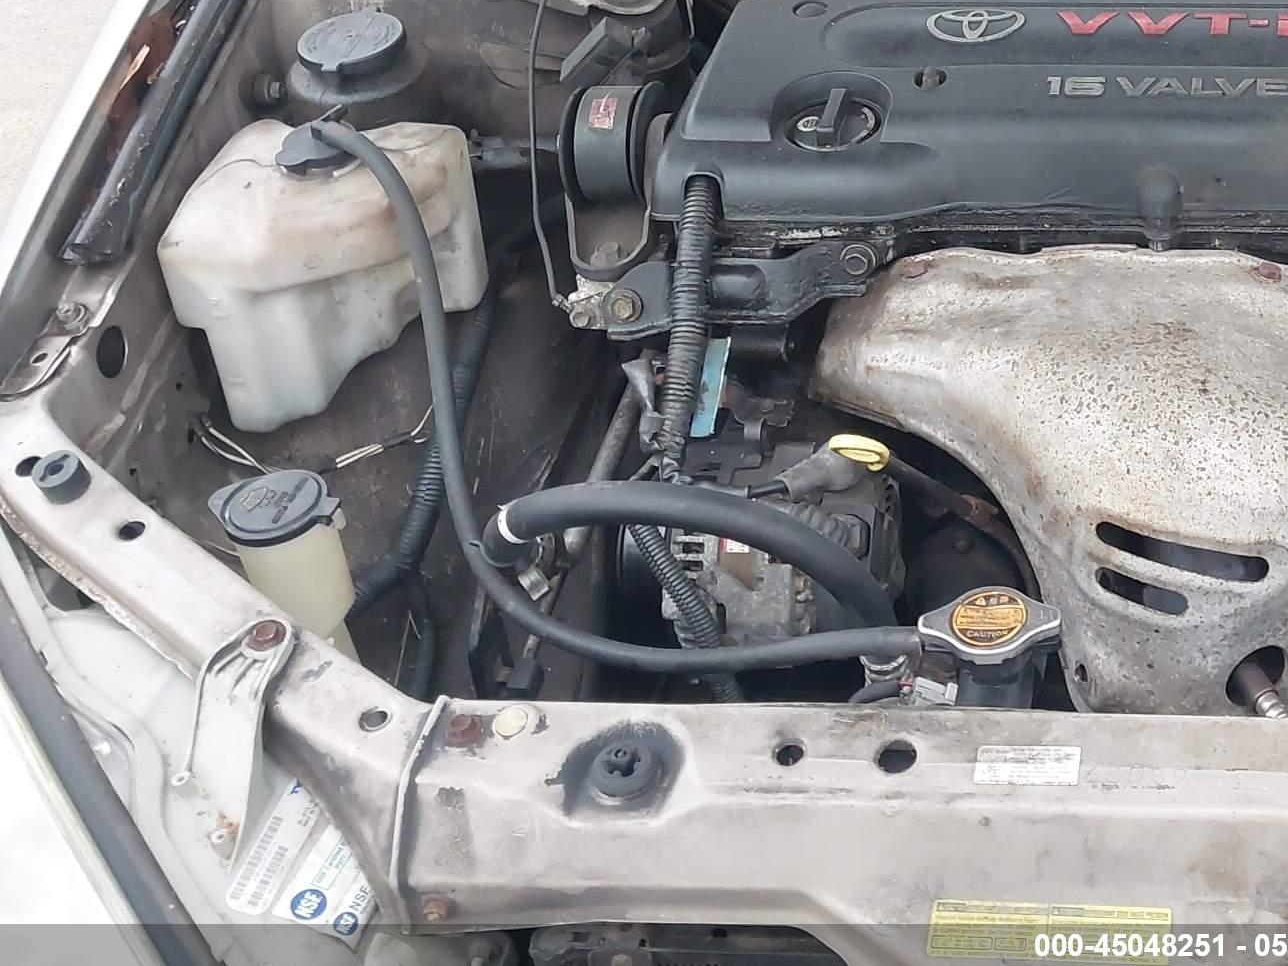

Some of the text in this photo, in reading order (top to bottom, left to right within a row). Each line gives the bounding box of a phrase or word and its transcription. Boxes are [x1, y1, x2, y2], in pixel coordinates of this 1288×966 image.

[1046, 75, 1106, 97] 16
[966, 628, 1009, 639] CAUTION
[294, 889, 323, 920] NSF
[349, 885, 371, 912] NSF
